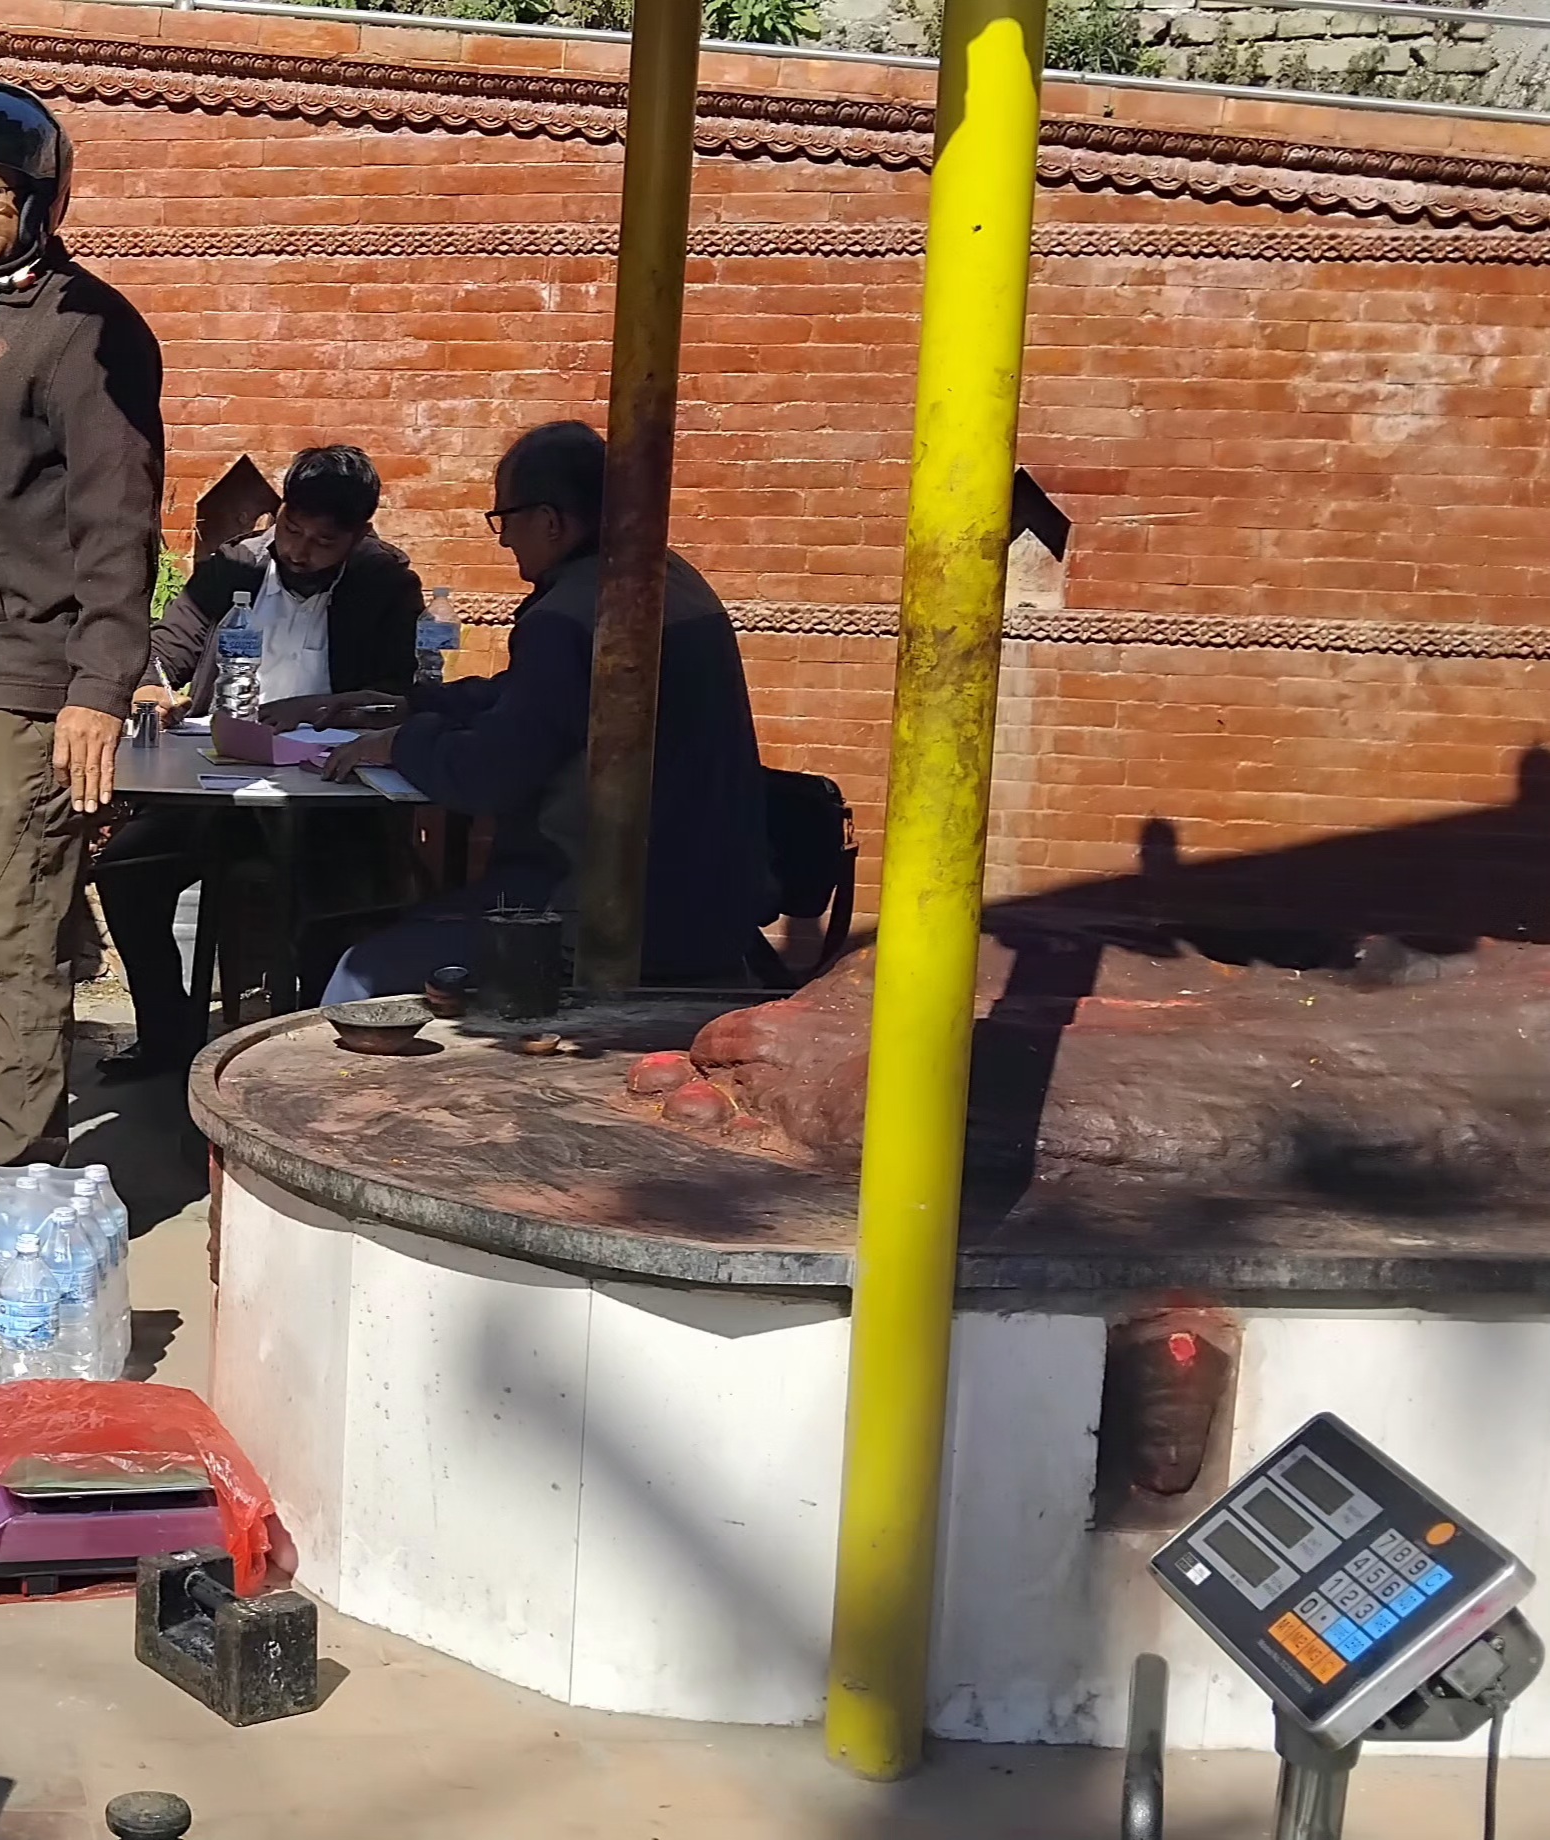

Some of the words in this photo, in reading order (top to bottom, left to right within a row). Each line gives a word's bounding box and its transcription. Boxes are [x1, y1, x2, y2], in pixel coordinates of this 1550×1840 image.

[1352, 1556, 1371, 1572] 4
[1366, 1567, 1387, 1584] 5
[1381, 1580, 1401, 1598] 6
[1378, 1533, 1398, 1549] 7
[1392, 1547, 1412, 1563] 8
[1408, 1559, 1429, 1576] 9
[1425, 1572, 1444, 1588] C
[1299, 1597, 1318, 1614] 0
[1328, 1577, 1344, 1592] 1
[1339, 1590, 1359, 1607] 2
[1354, 1602, 1375, 1620] 3
